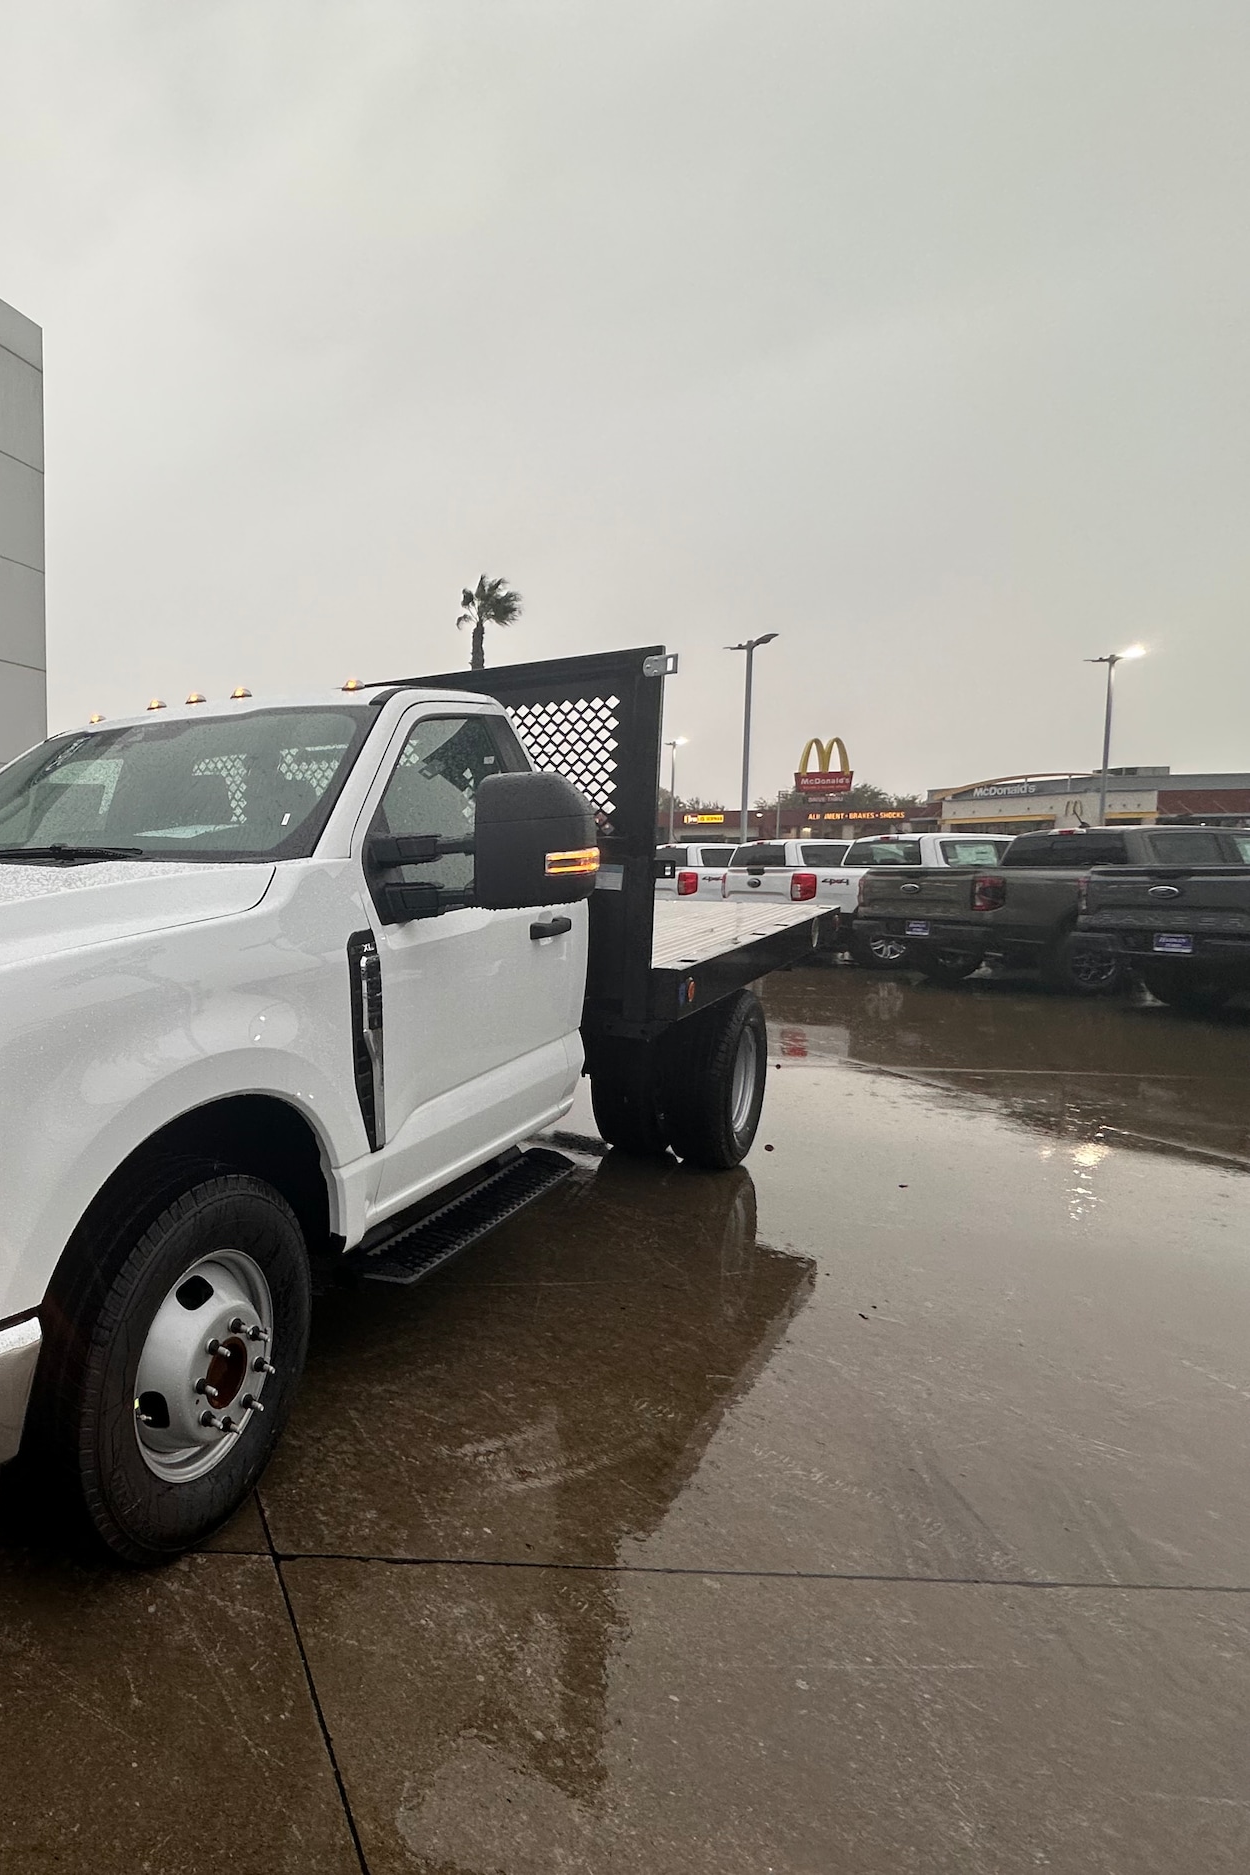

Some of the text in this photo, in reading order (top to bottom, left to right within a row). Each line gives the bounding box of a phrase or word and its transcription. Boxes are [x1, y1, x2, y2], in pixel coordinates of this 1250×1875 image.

[801, 777, 850, 785] McDonald's
[973, 784, 1036, 797] McDonald's
[879, 811, 905, 819] SHOCKS
[362, 943, 375, 952] XL
